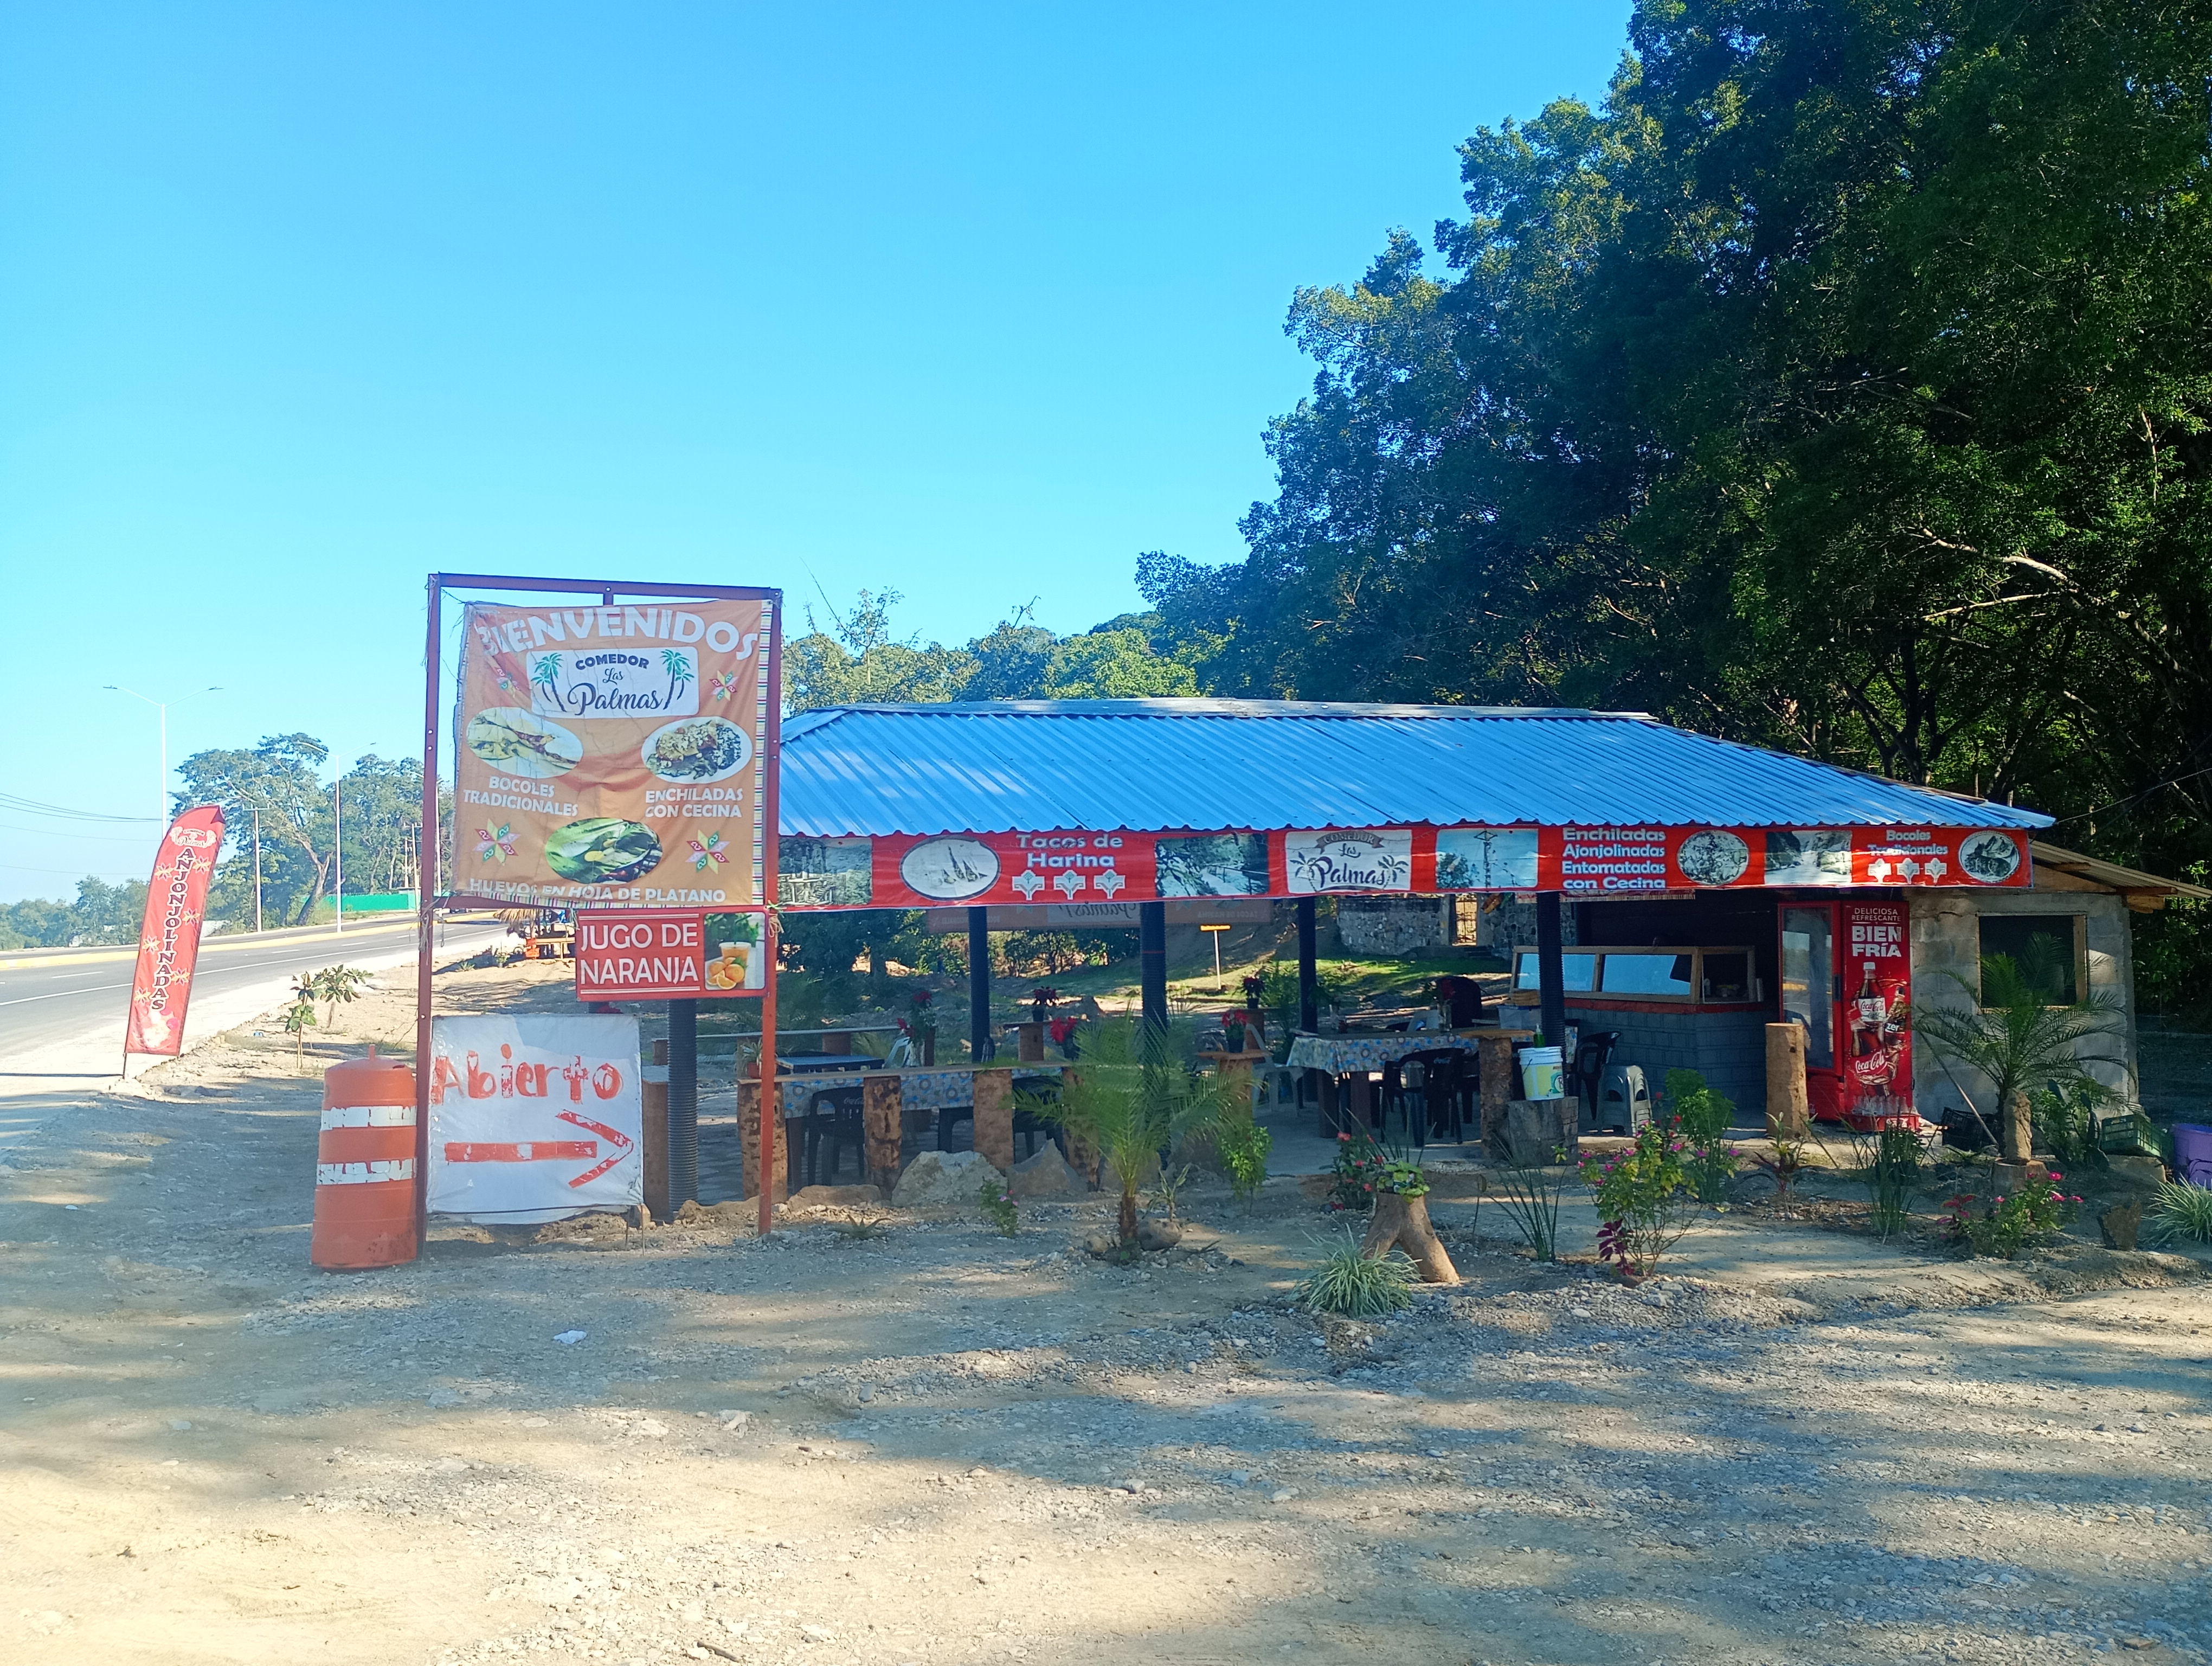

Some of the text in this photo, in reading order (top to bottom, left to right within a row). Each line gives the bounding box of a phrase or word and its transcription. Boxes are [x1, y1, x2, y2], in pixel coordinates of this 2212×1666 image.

[475, 607, 758, 660] BIENVENIDOS
[575, 653, 649, 670] COMEDOR
[603, 668, 625, 683] Las
[568, 682, 663, 715] Palmas
[489, 776, 555, 798] BOCOLES
[463, 789, 578, 817] TRADICIONALES
[646, 788, 743, 803] ENCHILADAS
[645, 804, 742, 818] CON CECINA
[1016, 834, 1123, 848] Tacos de
[1323, 831, 1374, 843] COMEDOR
[1562, 827, 1666, 841] Enchiladas
[1886, 829, 1931, 841] Bocoles
[1338, 843, 1361, 858] Las
[1562, 843, 1666, 860] Ajonjolinadas
[1027, 853, 1115, 868] Harina
[1562, 860, 1666, 874] Entomatadas
[1309, 856, 1385, 888] Palmas
[1562, 875, 1666, 889] con Cecina
[470, 878, 726, 902] HUEVOS EN HOJA DE PLATANO
[581, 923, 698, 952] JUGO DE
[1852, 926, 1902, 942] BIEN
[1852, 943, 1902, 957] FRÍA
[580, 956, 699, 985] NARANJA
[1861, 1001, 1884, 1012] Coca-Cola
[1886, 1023, 1900, 1031] zer
[1856, 1050, 1887, 1074] Coca-Cola
[432, 1043, 623, 1105] Abierto
